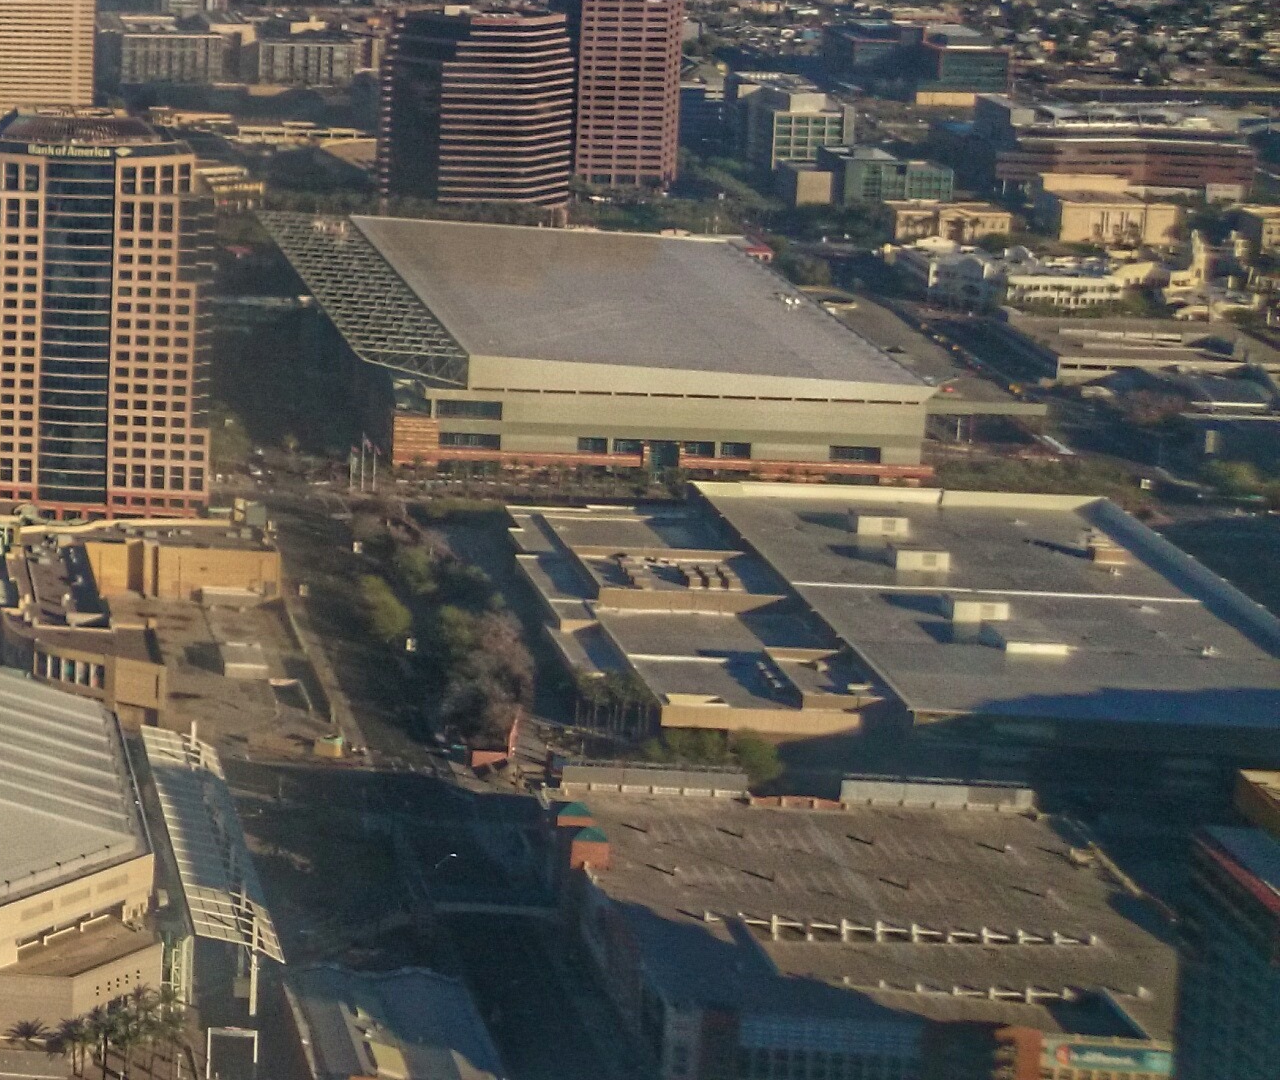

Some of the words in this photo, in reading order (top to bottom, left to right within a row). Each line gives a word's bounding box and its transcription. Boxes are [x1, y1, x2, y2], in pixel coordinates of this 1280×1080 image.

[27, 143, 54, 155] Bank
[55, 145, 66, 156] of
[67, 146, 111, 157] America
